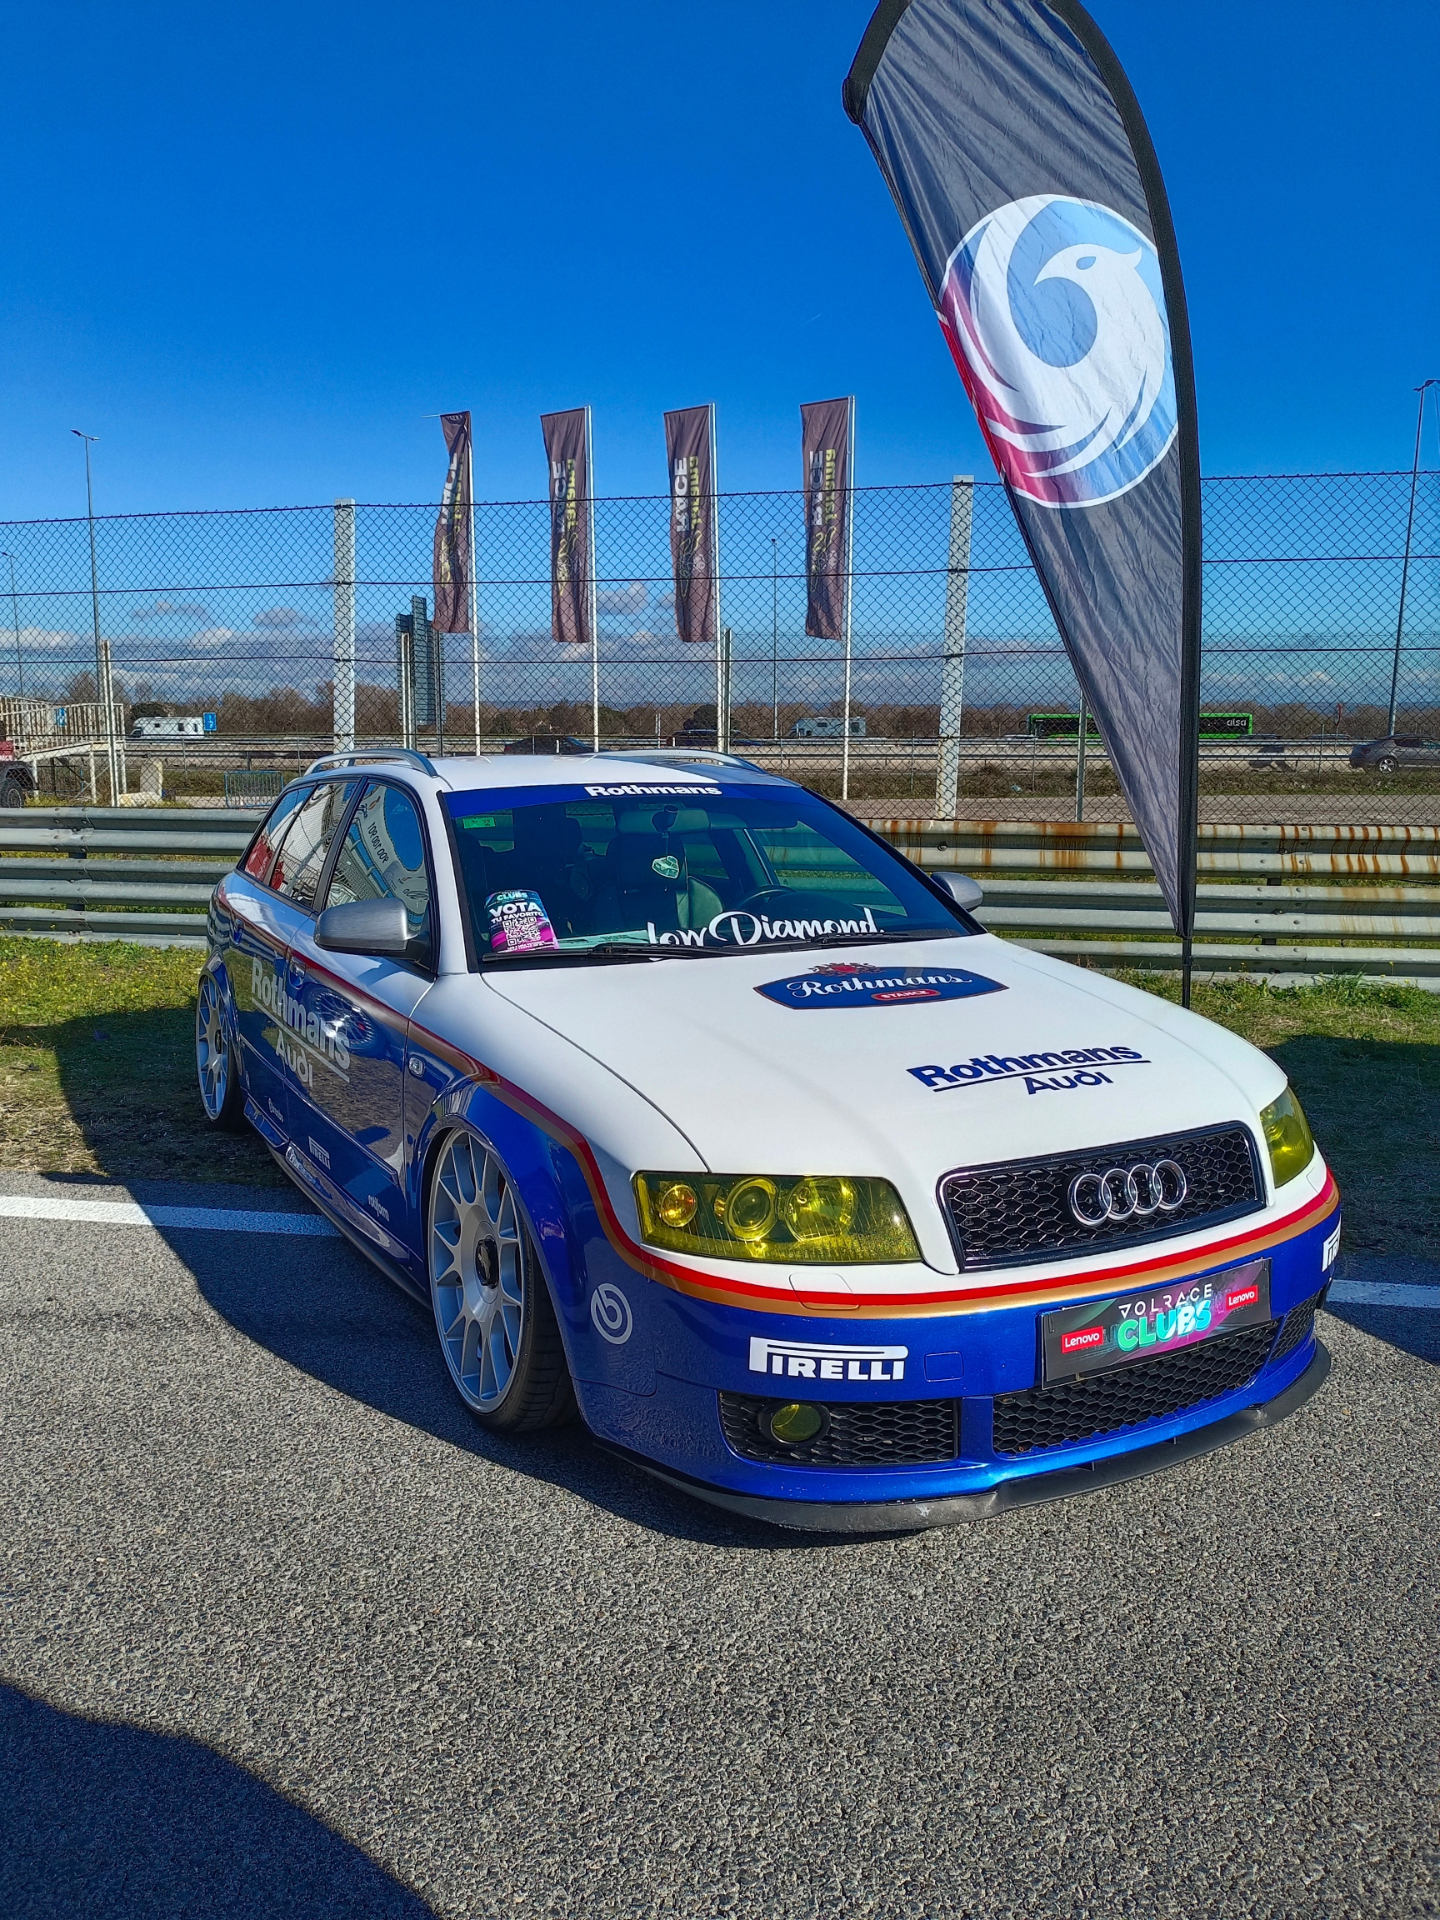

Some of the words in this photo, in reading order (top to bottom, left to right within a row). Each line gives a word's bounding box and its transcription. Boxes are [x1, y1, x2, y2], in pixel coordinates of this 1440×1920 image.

[1226, 718, 1247, 727] alsa
[584, 783, 723, 798] Rothmans
[489, 902, 542, 917] VOTA
[491, 916, 503, 924] TU
[503, 911, 545, 921] FAVORITO
[786, 968, 972, 998] Rothmans
[252, 956, 351, 1070] Rothmans
[275, 1029, 313, 1088] Audi
[906, 1044, 1143, 1088] Rothmans
[1024, 1070, 1114, 1096] Audi
[308, 1135, 331, 1170] PIRELLI
[1118, 1283, 1213, 1318] VOLRACE
[1228, 1290, 1255, 1307] Lenovo
[1064, 1332, 1100, 1348] Lenovo
[1117, 1299, 1212, 1353] CLUBS
[749, 1336, 908, 1381] PIRELLI
